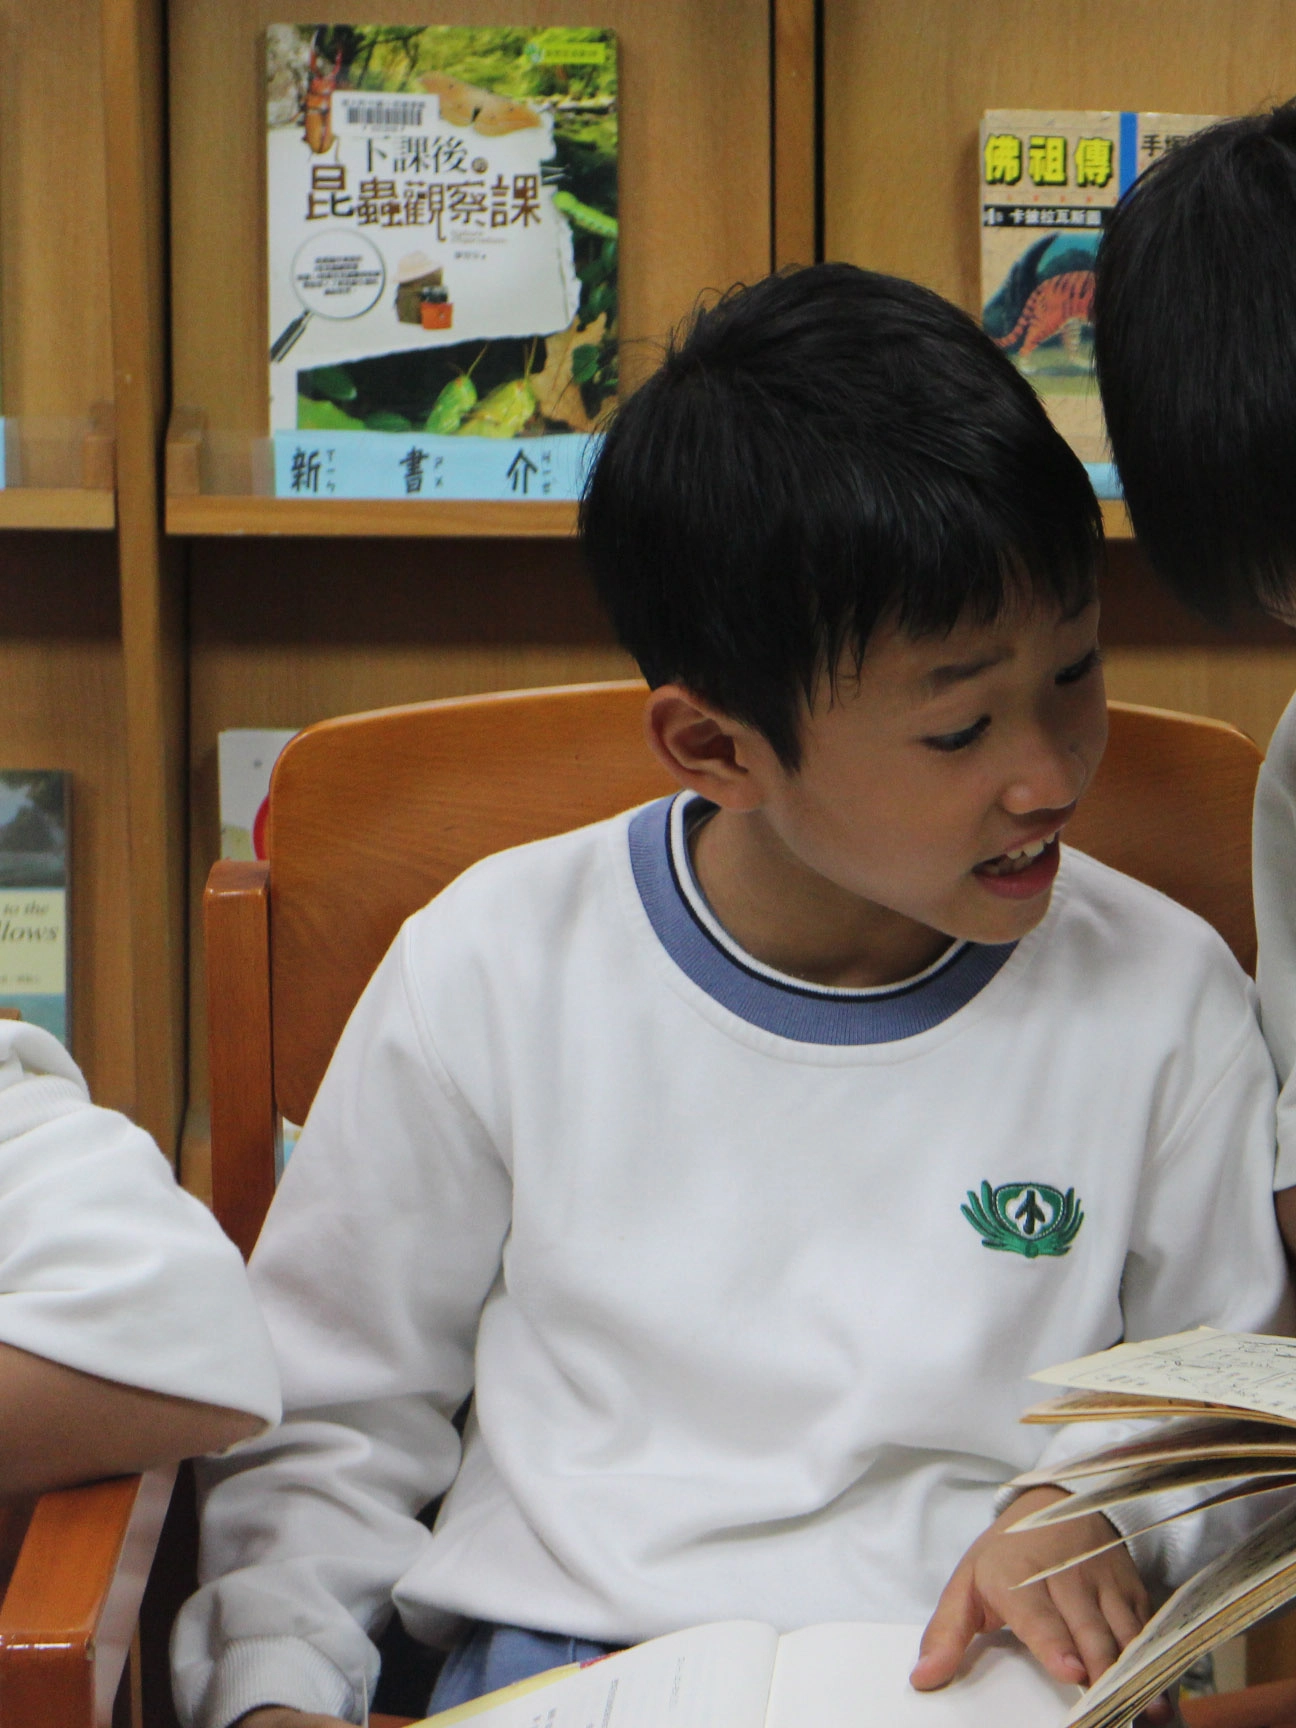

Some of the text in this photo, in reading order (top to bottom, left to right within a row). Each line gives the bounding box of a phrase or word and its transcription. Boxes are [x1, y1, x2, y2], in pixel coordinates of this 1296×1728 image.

[984, 133, 1113, 187] 佛祖傳
[305, 164, 541, 243] 昆蟲觀察課
